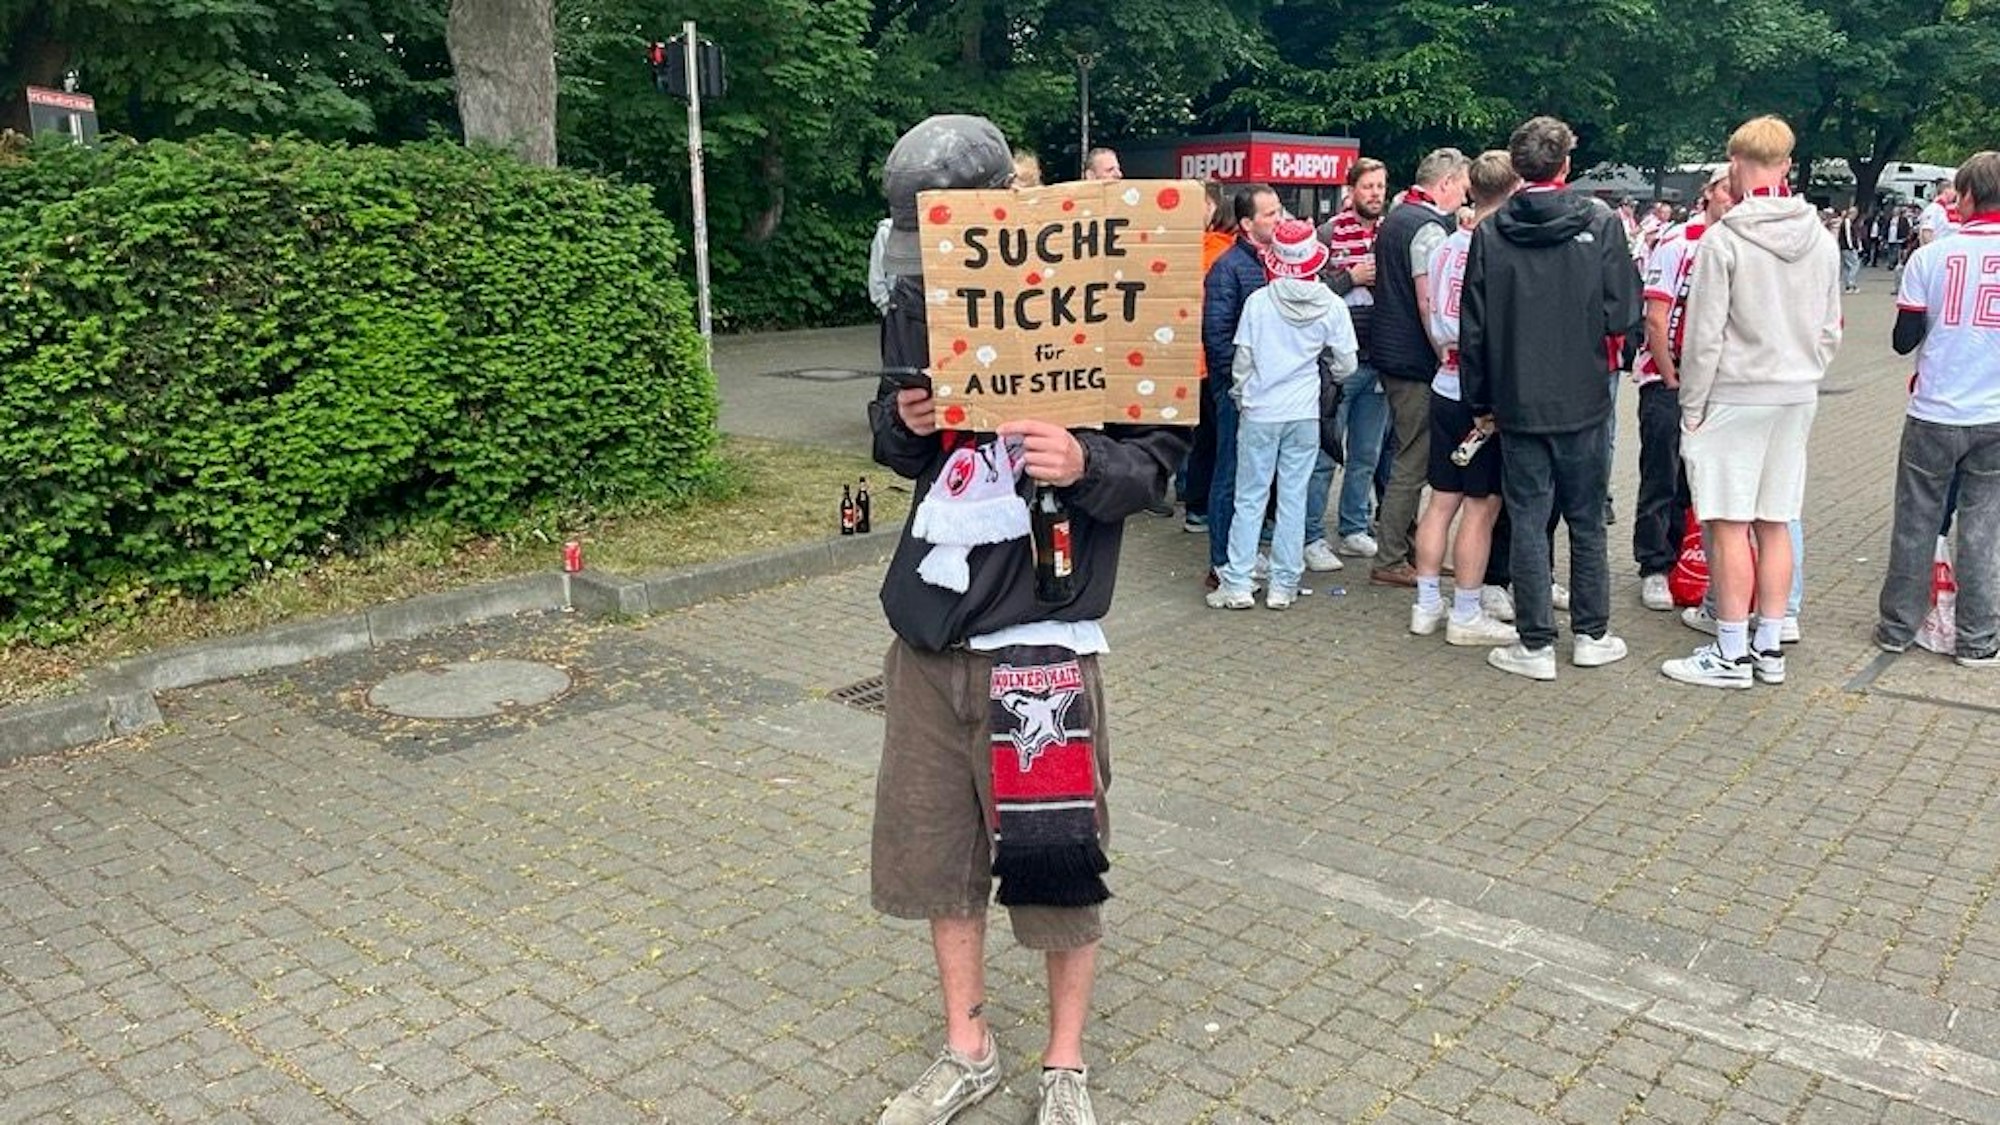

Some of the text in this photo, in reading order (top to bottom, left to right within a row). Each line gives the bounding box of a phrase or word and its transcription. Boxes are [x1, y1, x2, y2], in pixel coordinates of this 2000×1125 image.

[1181, 151, 1247, 179] DEPOT
[1271, 152, 1339, 178] FC-DEPOT
[963, 219, 1129, 269] SUCHE
[957, 282, 1146, 330] TICKET
[1035, 343, 1066, 362] für
[965, 367, 1107, 396] AUFSTIEG
